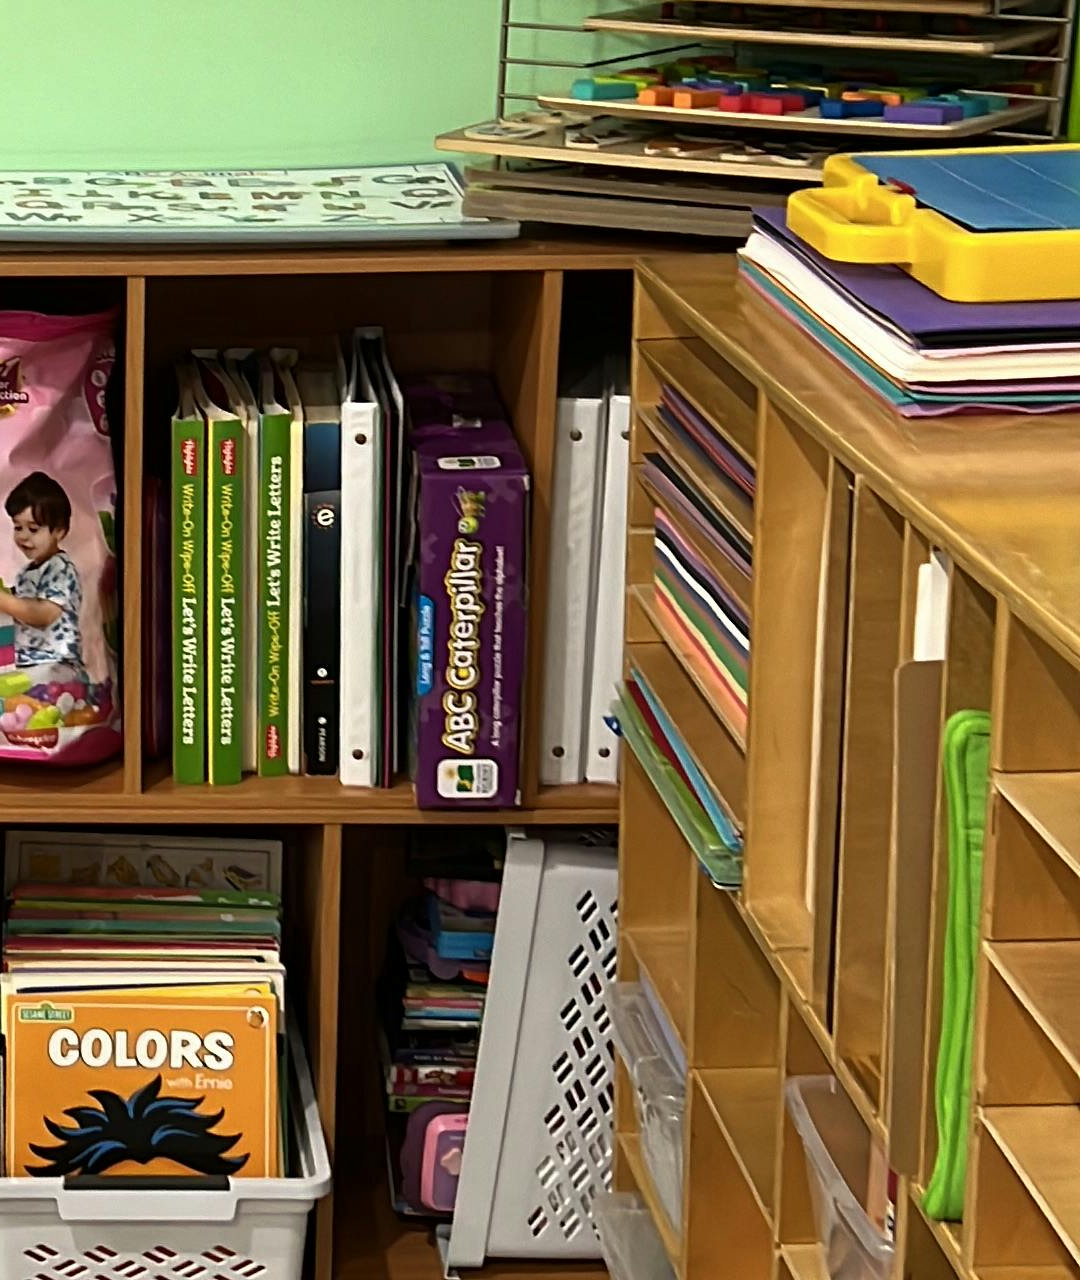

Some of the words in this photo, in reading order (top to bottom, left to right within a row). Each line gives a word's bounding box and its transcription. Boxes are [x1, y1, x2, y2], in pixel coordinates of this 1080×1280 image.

[267, 456, 283, 516] Letters
[266, 520, 282, 567] Write
[266, 569, 282, 607] Let's
[494, 586, 504, 599] the
[182, 597, 197, 635] Let's
[220, 597, 235, 635] Let's
[447, 541, 483, 687] Caterpillar
[182, 637, 197, 684] Write
[220, 637, 235, 684] Write
[182, 687, 197, 745] Letters
[220, 687, 235, 745] Letters
[446, 692, 478, 752] ABC
[48, 1028, 235, 1071] COLORS
[167, 1075, 193, 1088] with
[195, 1073, 233, 1090] Ernie
